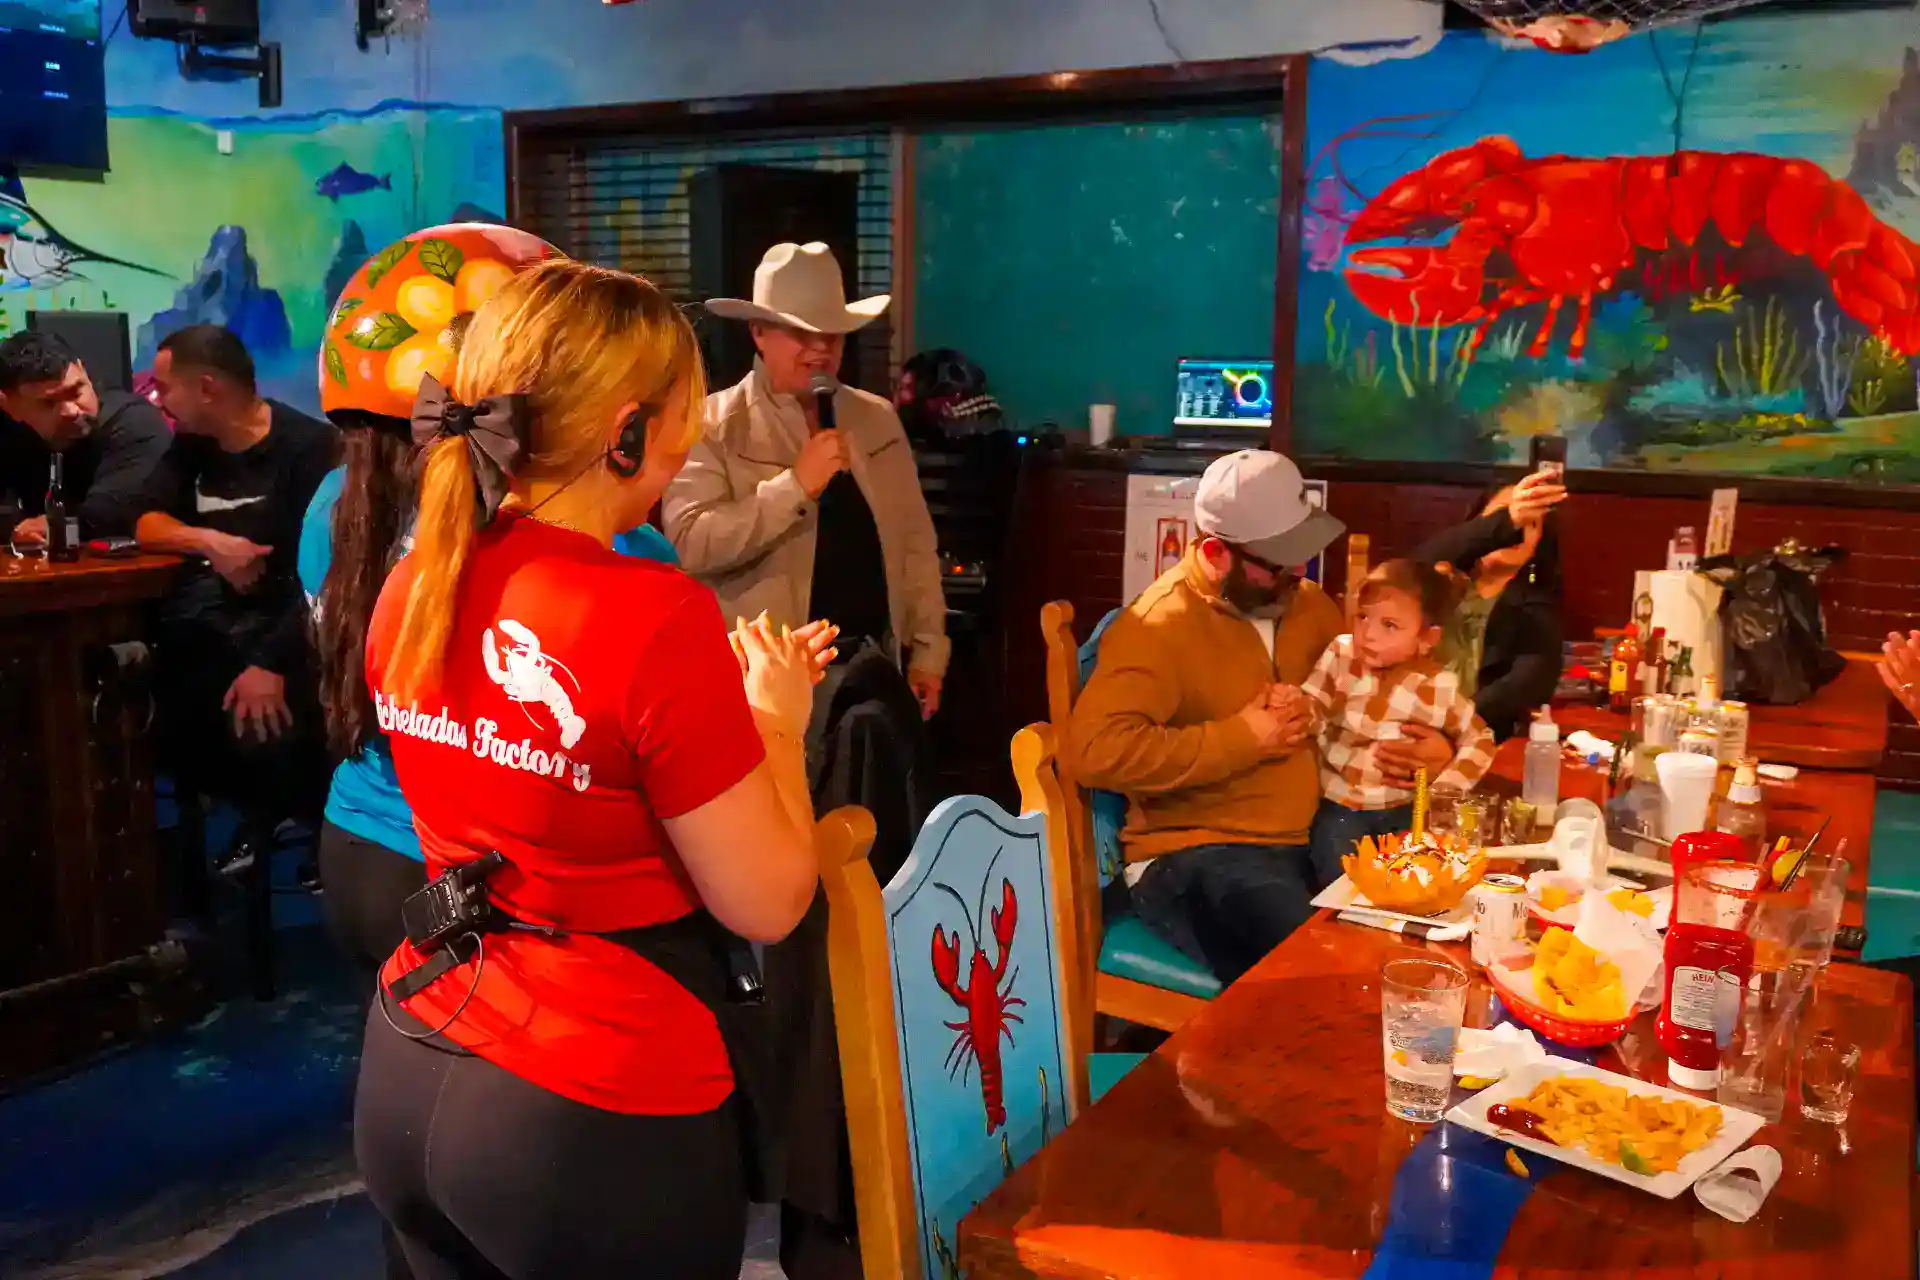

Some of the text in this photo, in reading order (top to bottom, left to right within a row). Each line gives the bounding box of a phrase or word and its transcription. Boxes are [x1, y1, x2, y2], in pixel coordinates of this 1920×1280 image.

[374, 686, 591, 792] icheladas Factory
[1692, 973, 1715, 984] HEIN
